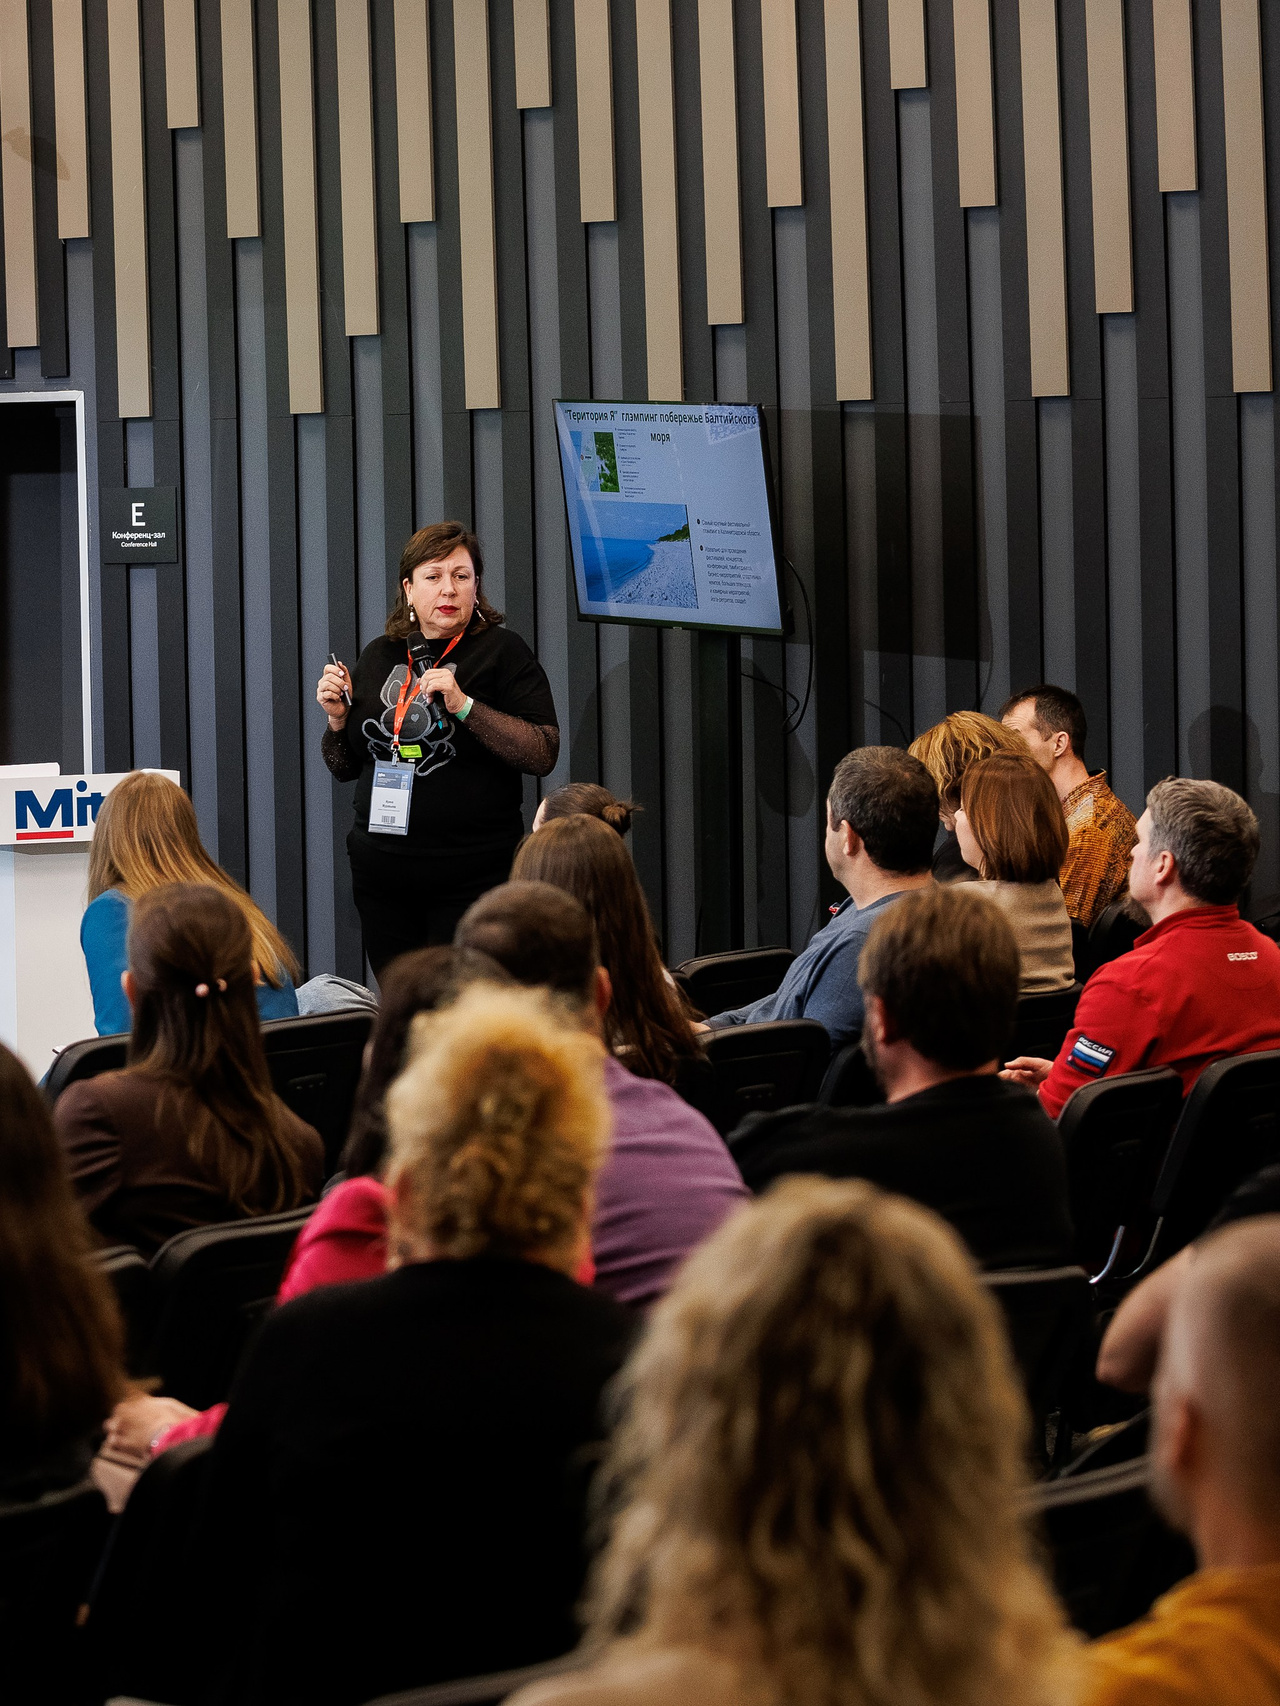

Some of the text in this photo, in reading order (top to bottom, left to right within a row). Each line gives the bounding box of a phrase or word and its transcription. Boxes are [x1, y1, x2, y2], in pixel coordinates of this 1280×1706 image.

[621, 412, 658, 423] глэмпинг
[659, 411, 703, 426] побережье
[705, 411, 757, 426] Балтийского
[650, 432, 671, 445] моря
[111, 531, 166, 541] Конференц-зал
[14, 779, 108, 830] Mit
